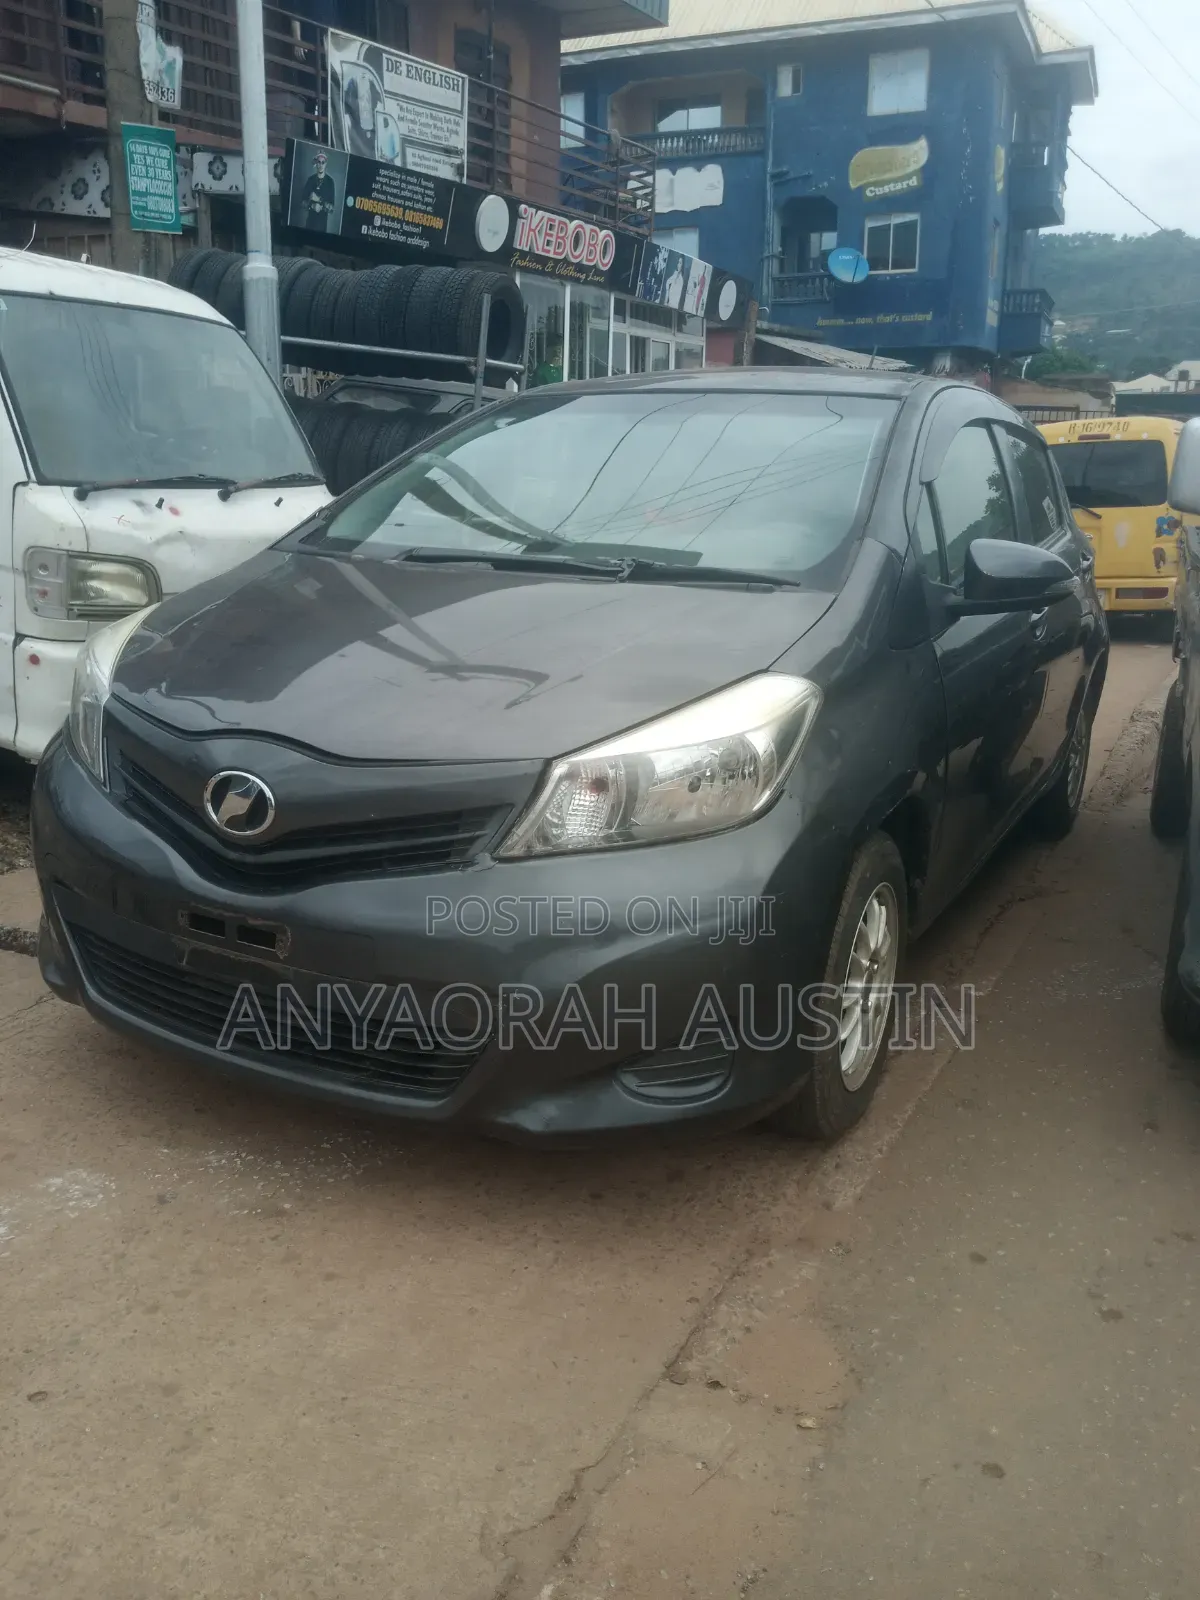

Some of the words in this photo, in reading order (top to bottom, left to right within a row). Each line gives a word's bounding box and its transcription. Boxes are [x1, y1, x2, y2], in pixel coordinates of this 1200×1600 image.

[385, 57, 402, 76] DE
[405, 63, 461, 93] ENGLISH
[133, 153, 145, 165] YES
[145, 155, 154, 166] WE
[155, 157, 168, 170] CURE
[131, 164, 147, 177] EVEN
[155, 168, 172, 181] YEARS
[866, 176, 918, 197] Custard
[511, 252, 543, 272] Fashion
[545, 260, 554, 272] &
[556, 261, 586, 283] Clothing
[587, 268, 605, 282] Line
[876, 313, 900, 323] that's
[901, 311, 933, 321] custard
